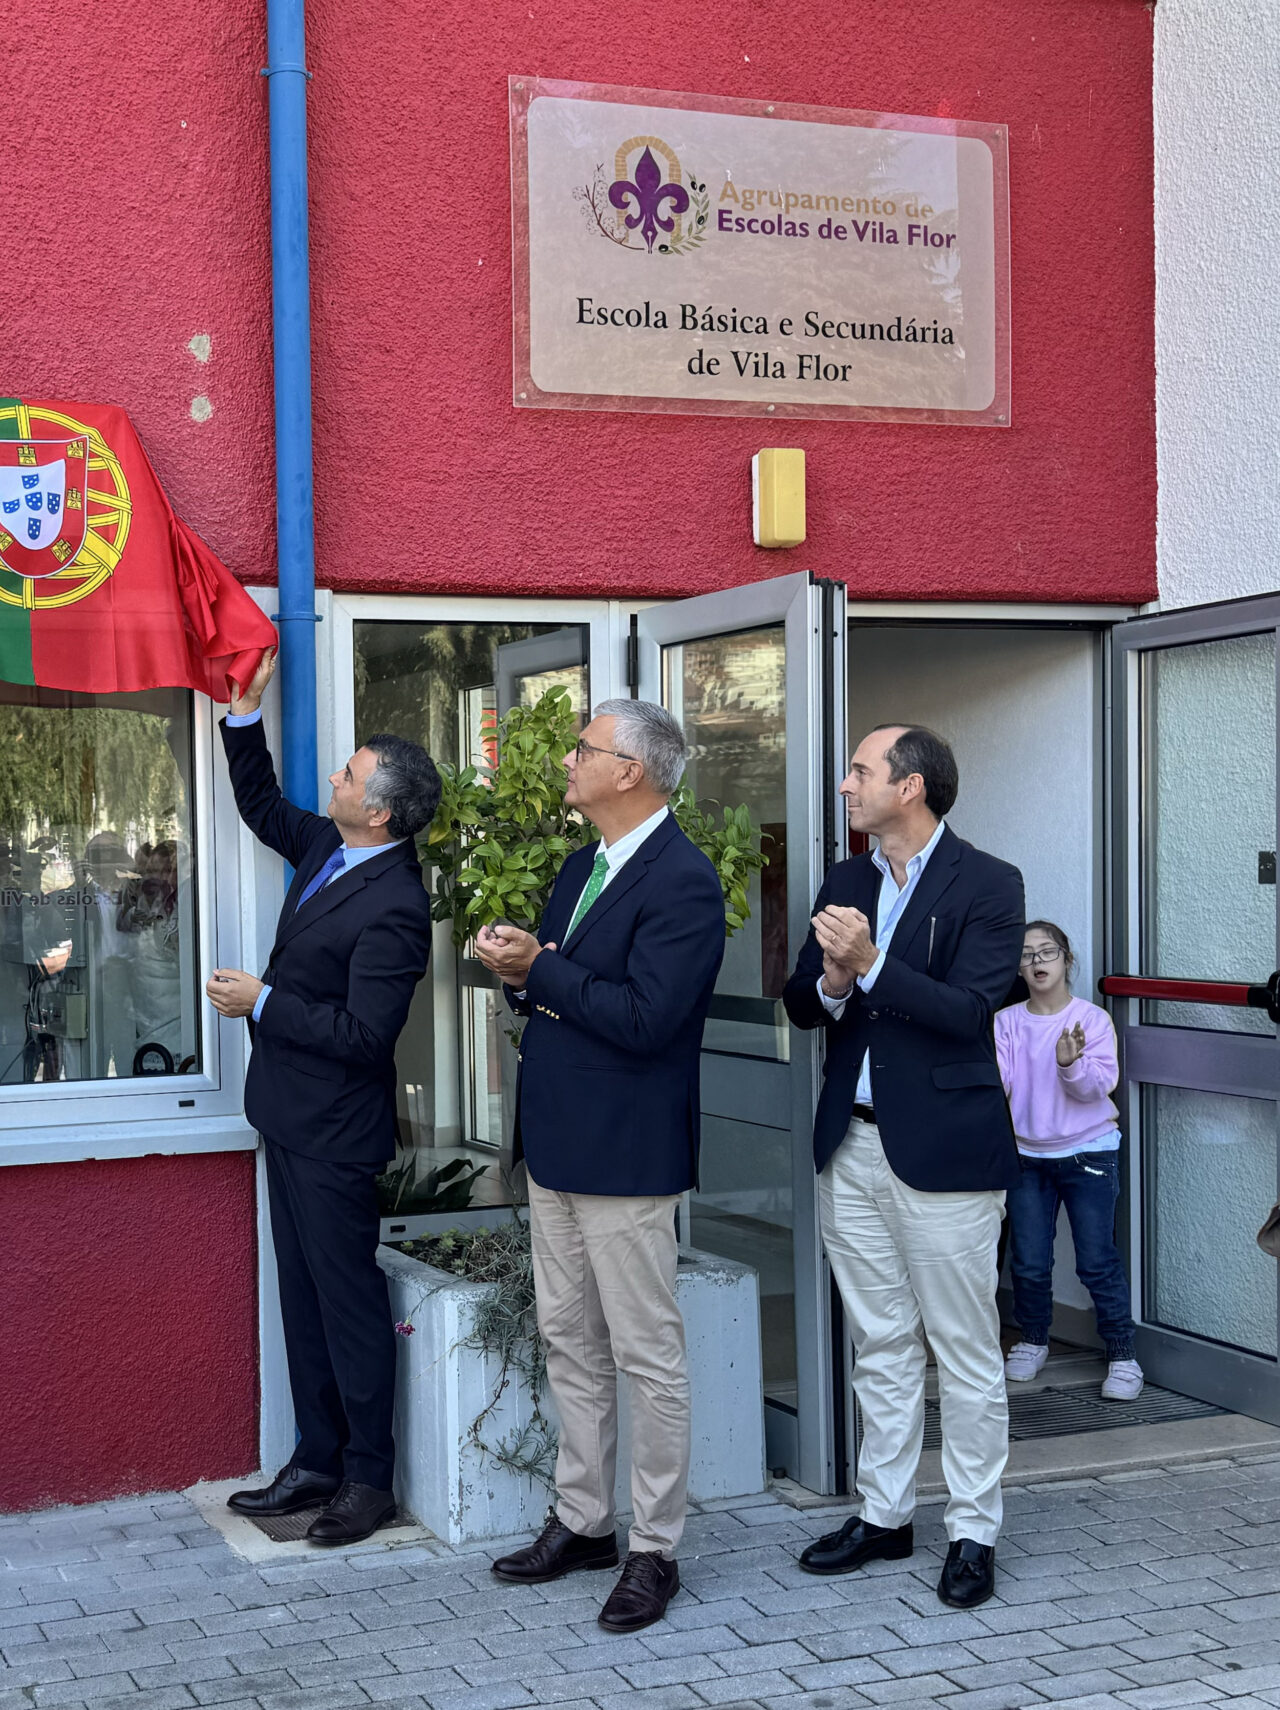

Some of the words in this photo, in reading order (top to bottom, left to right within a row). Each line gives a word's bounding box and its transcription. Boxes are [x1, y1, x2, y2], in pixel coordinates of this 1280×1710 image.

[719, 180, 898, 216] Agrupamento
[905, 198, 934, 219] de
[717, 209, 810, 239] Escolas
[818, 216, 848, 241] de
[850, 217, 900, 245] Vila
[907, 222, 957, 249] Flor
[575, 297, 669, 329] Escola
[679, 304, 769, 335] Básica
[778, 314, 794, 337] e
[804, 311, 955, 345] Secundária
[687, 349, 721, 376] de
[731, 351, 786, 379] Vila
[796, 354, 853, 383] Flor
